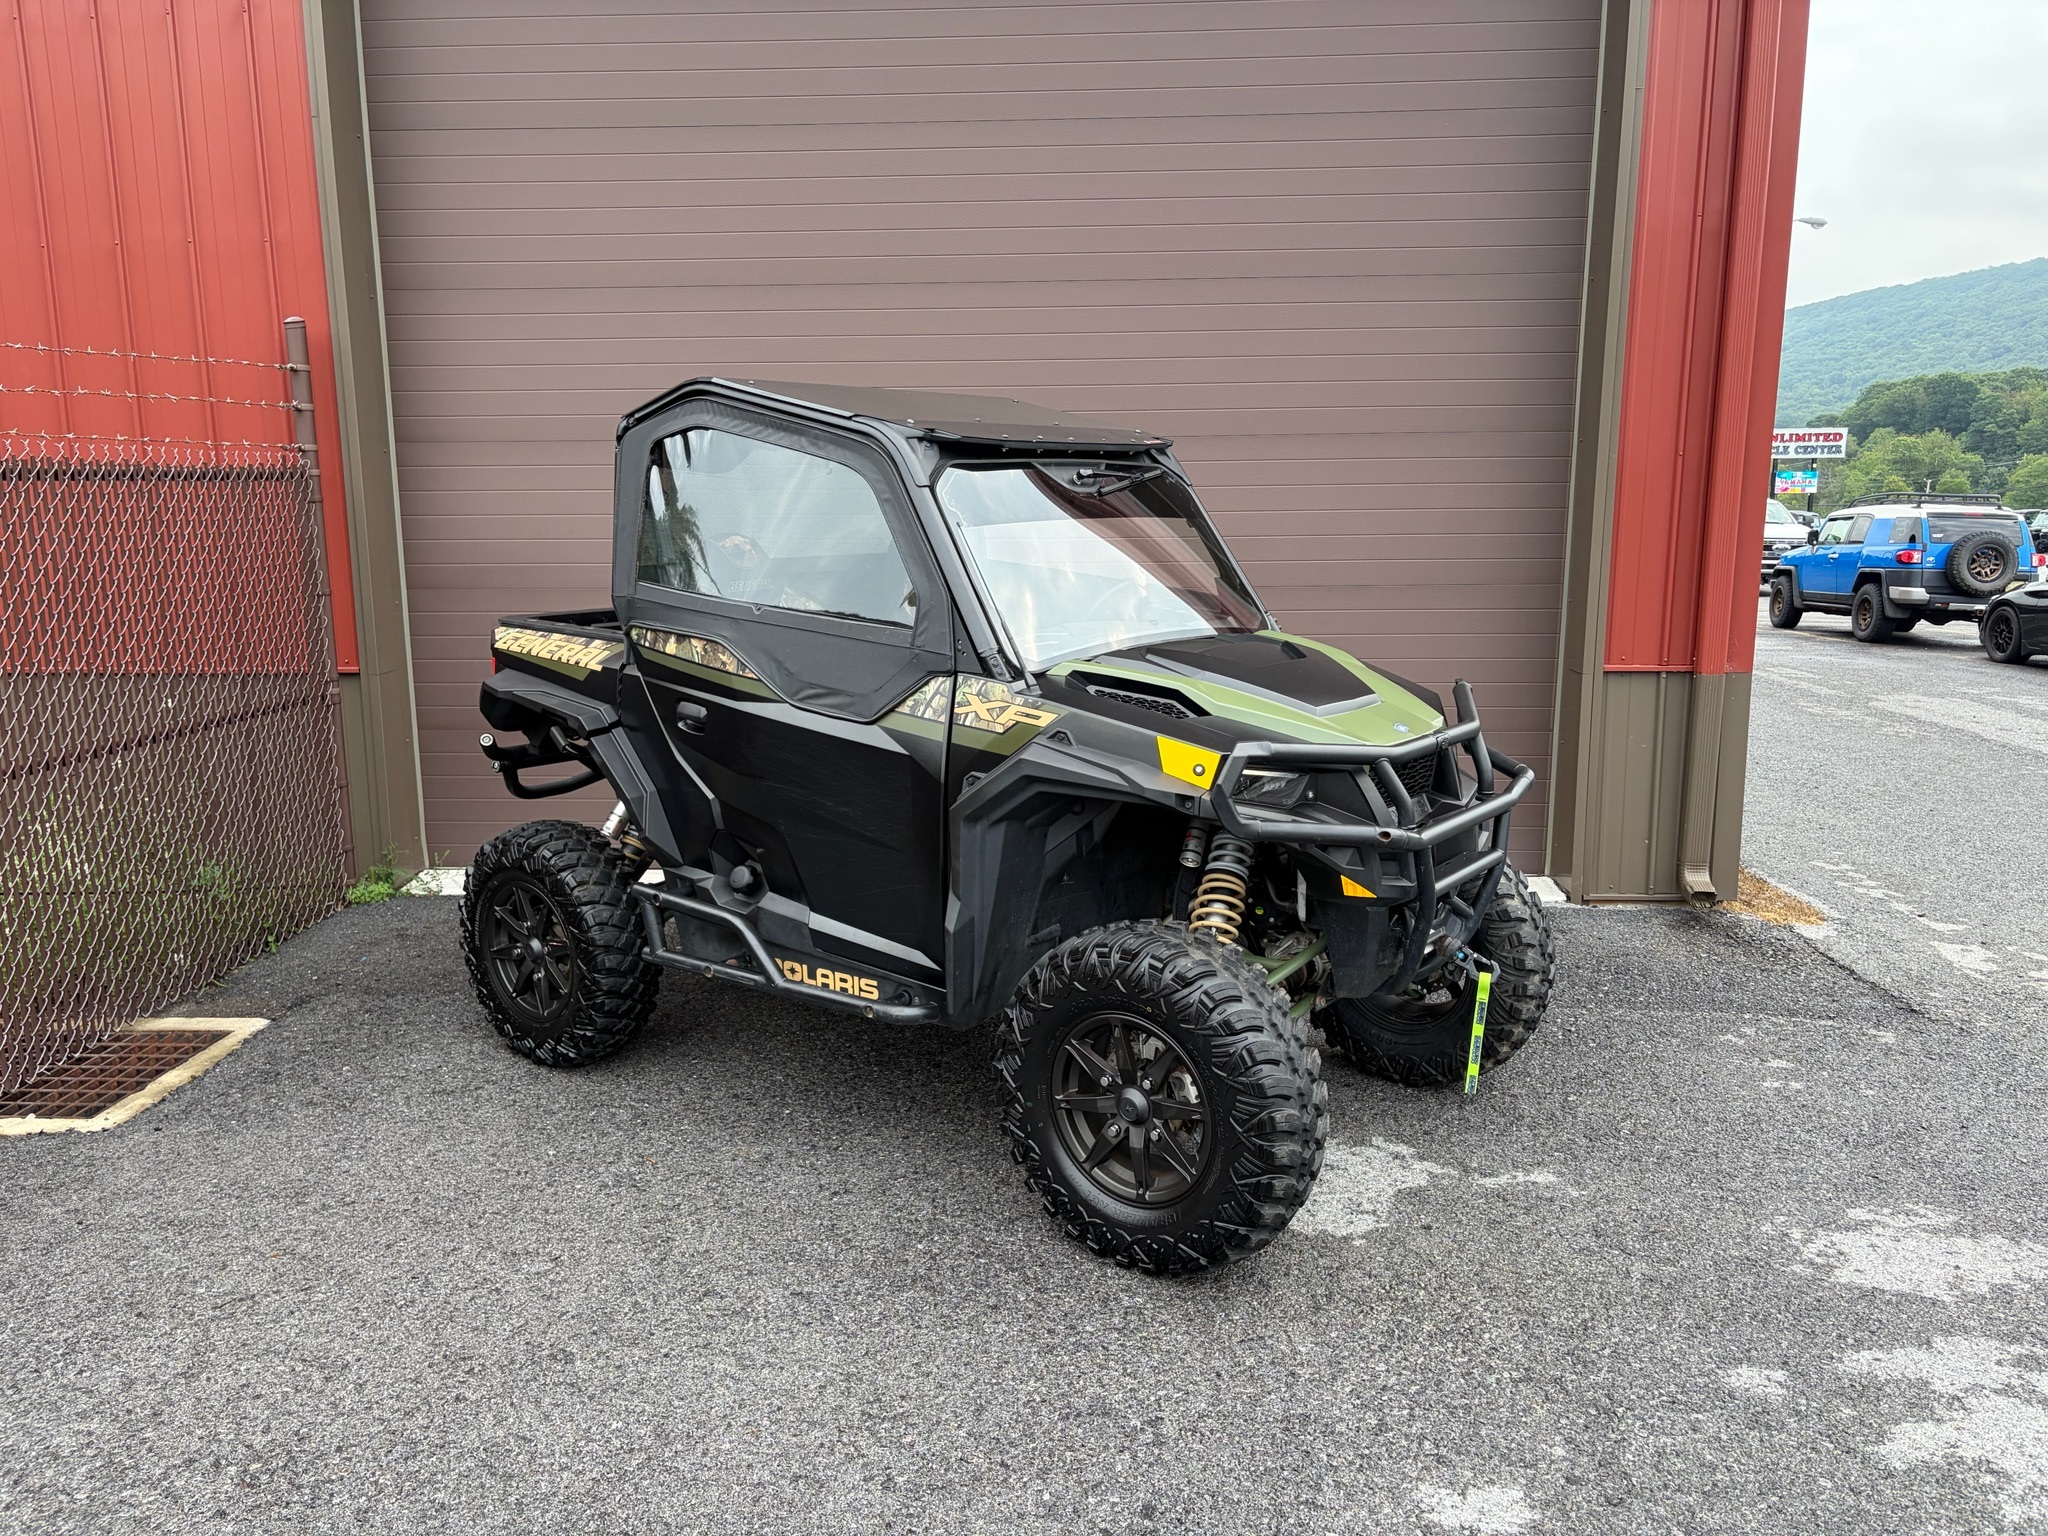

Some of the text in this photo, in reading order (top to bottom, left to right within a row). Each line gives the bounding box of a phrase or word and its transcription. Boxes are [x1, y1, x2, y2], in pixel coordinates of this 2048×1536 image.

[1794, 444, 1843, 455] CENTER
[494, 632, 612, 672] GENERAL
[954, 692, 1061, 728] XP
